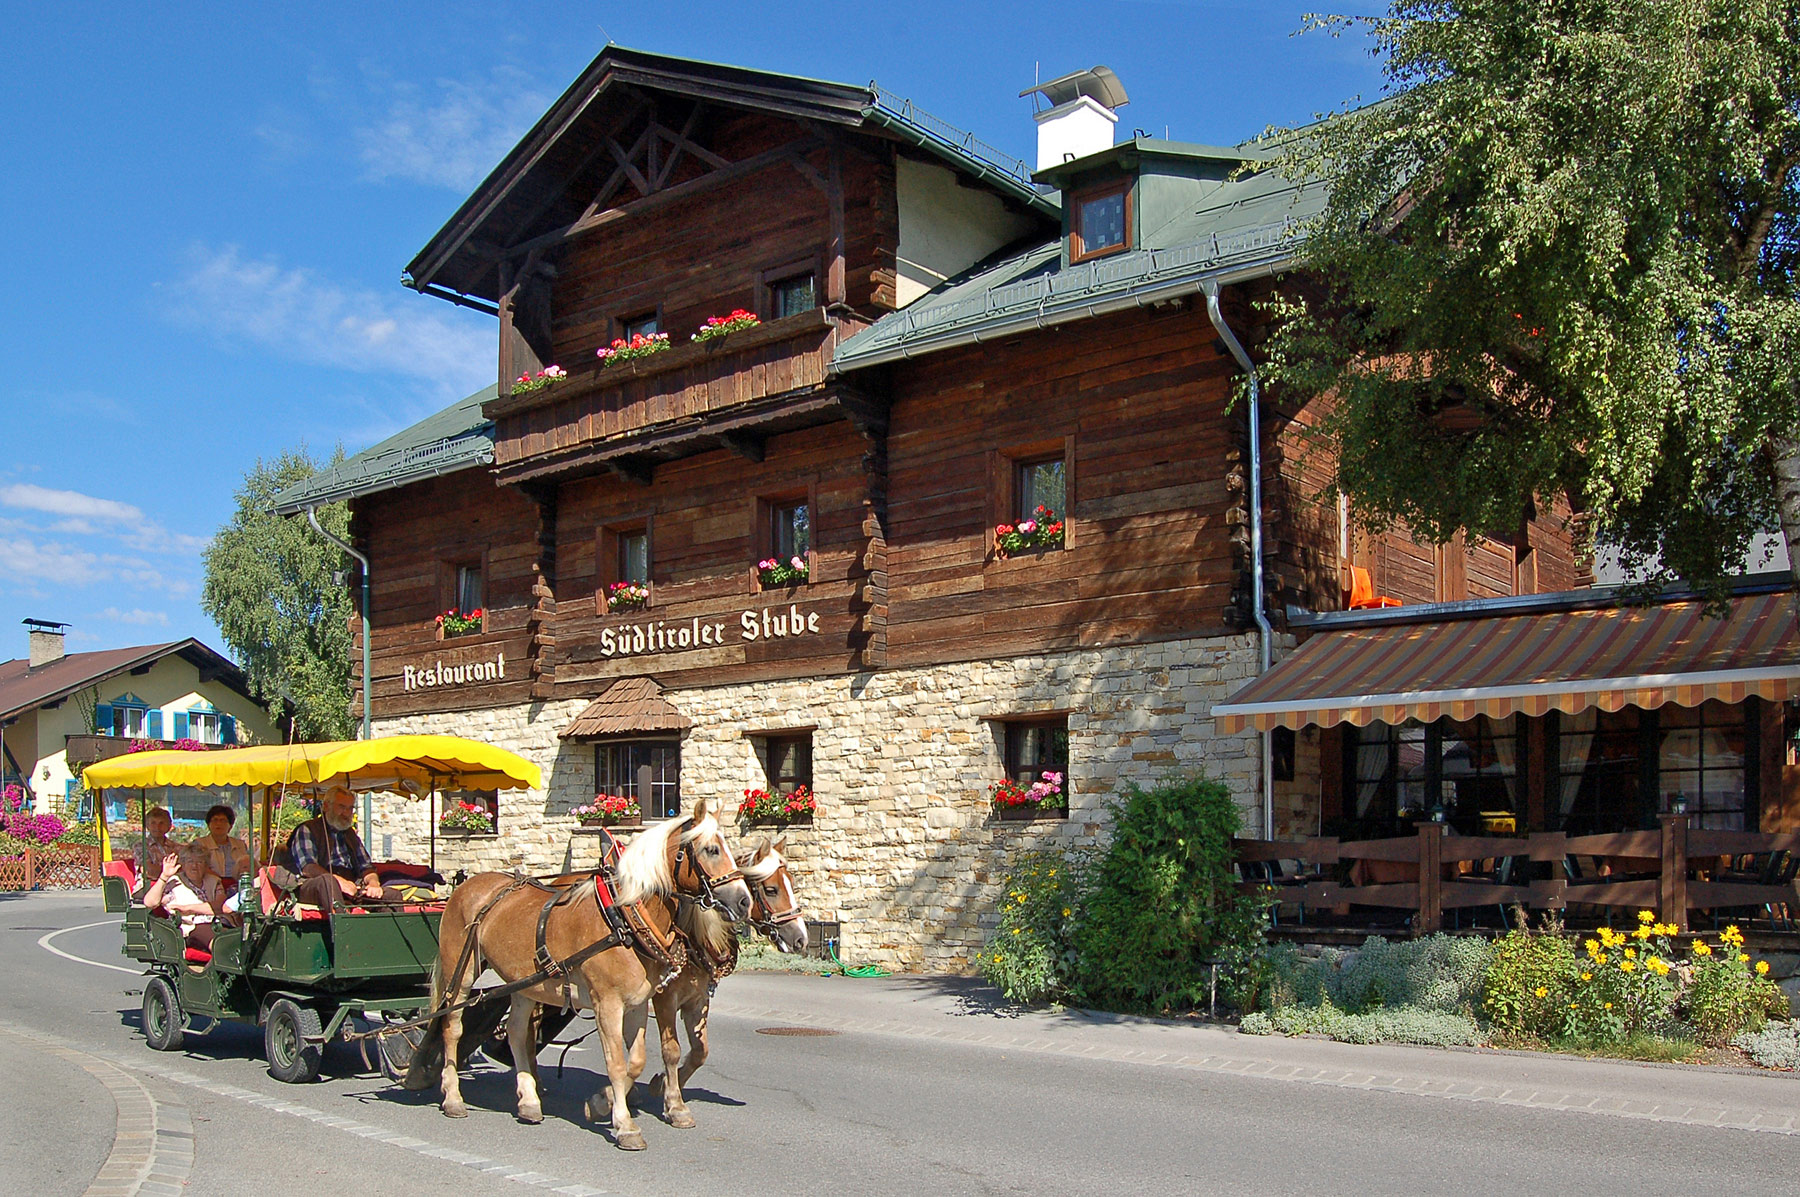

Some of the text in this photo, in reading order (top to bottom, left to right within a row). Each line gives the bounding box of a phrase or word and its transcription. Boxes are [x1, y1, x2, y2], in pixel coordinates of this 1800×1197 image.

[600, 604, 820, 657] Südtiroler Stube
[403, 652, 506, 691] Restaurant
